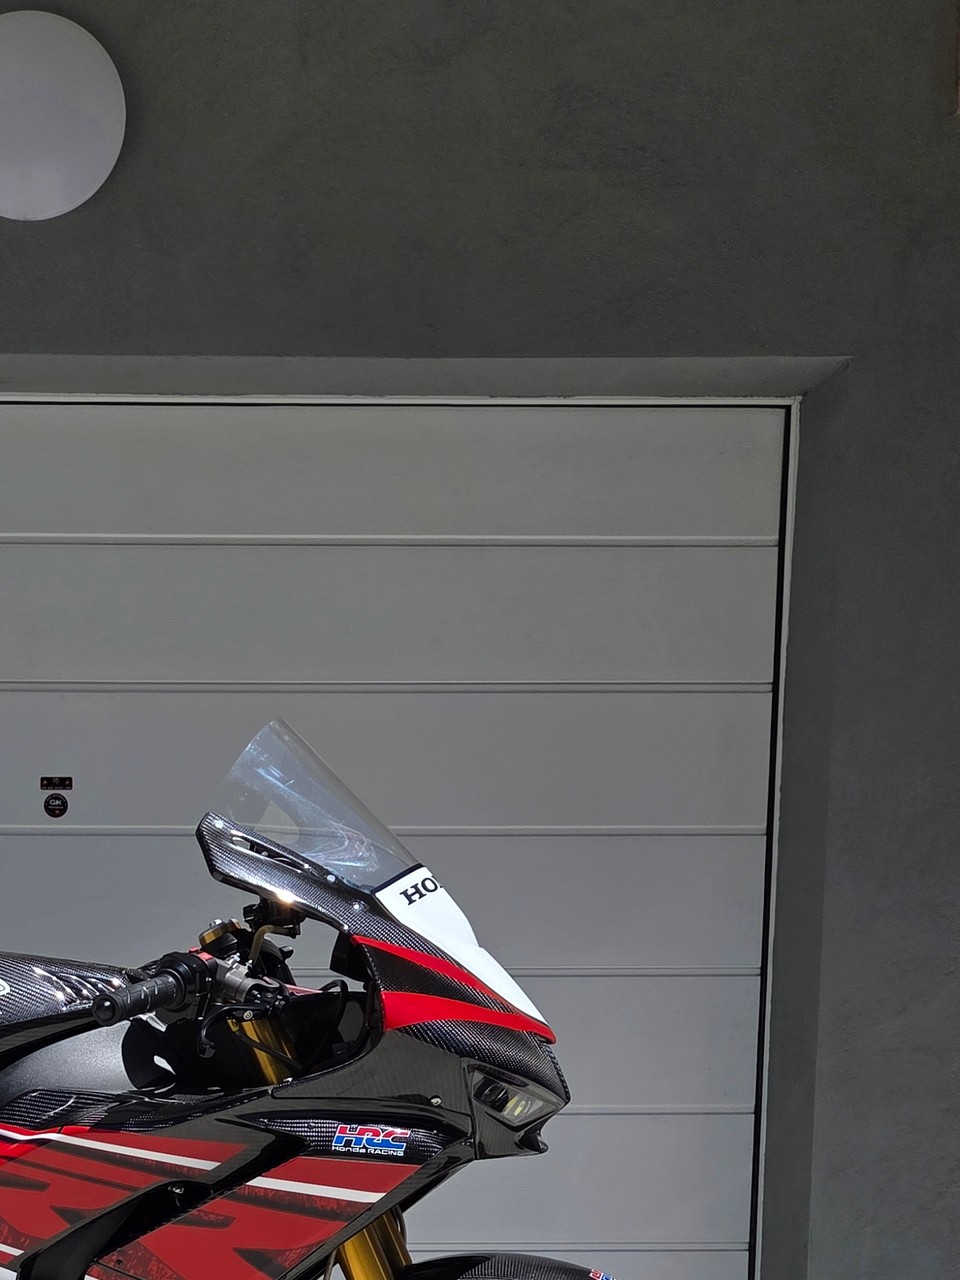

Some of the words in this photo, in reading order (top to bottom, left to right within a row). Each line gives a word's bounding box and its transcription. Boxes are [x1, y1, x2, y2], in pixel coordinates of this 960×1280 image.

[399, 876, 442, 906] HO
[331, 1145, 366, 1153] Honda
[367, 1148, 405, 1157] RACING
[332, 1124, 411, 1151] HRC
